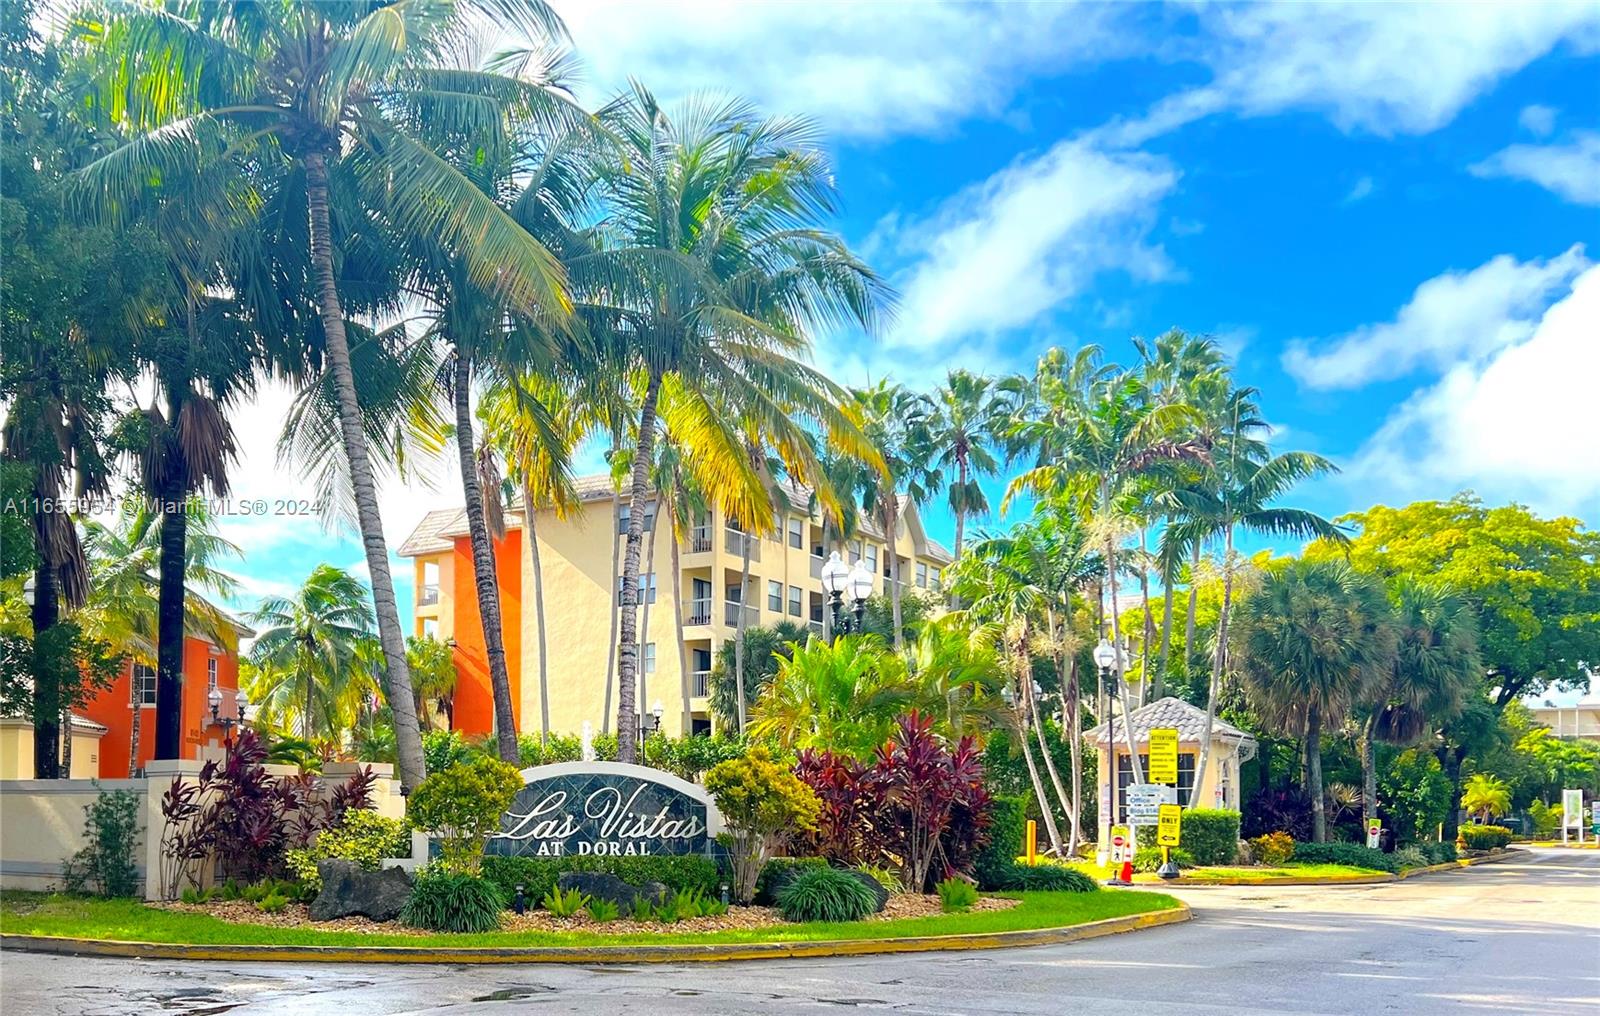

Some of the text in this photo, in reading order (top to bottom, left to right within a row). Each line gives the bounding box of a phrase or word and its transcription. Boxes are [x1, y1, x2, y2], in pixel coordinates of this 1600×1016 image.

[490, 783, 707, 839] Las Vistas
[537, 841, 651, 856] AT DORAL
